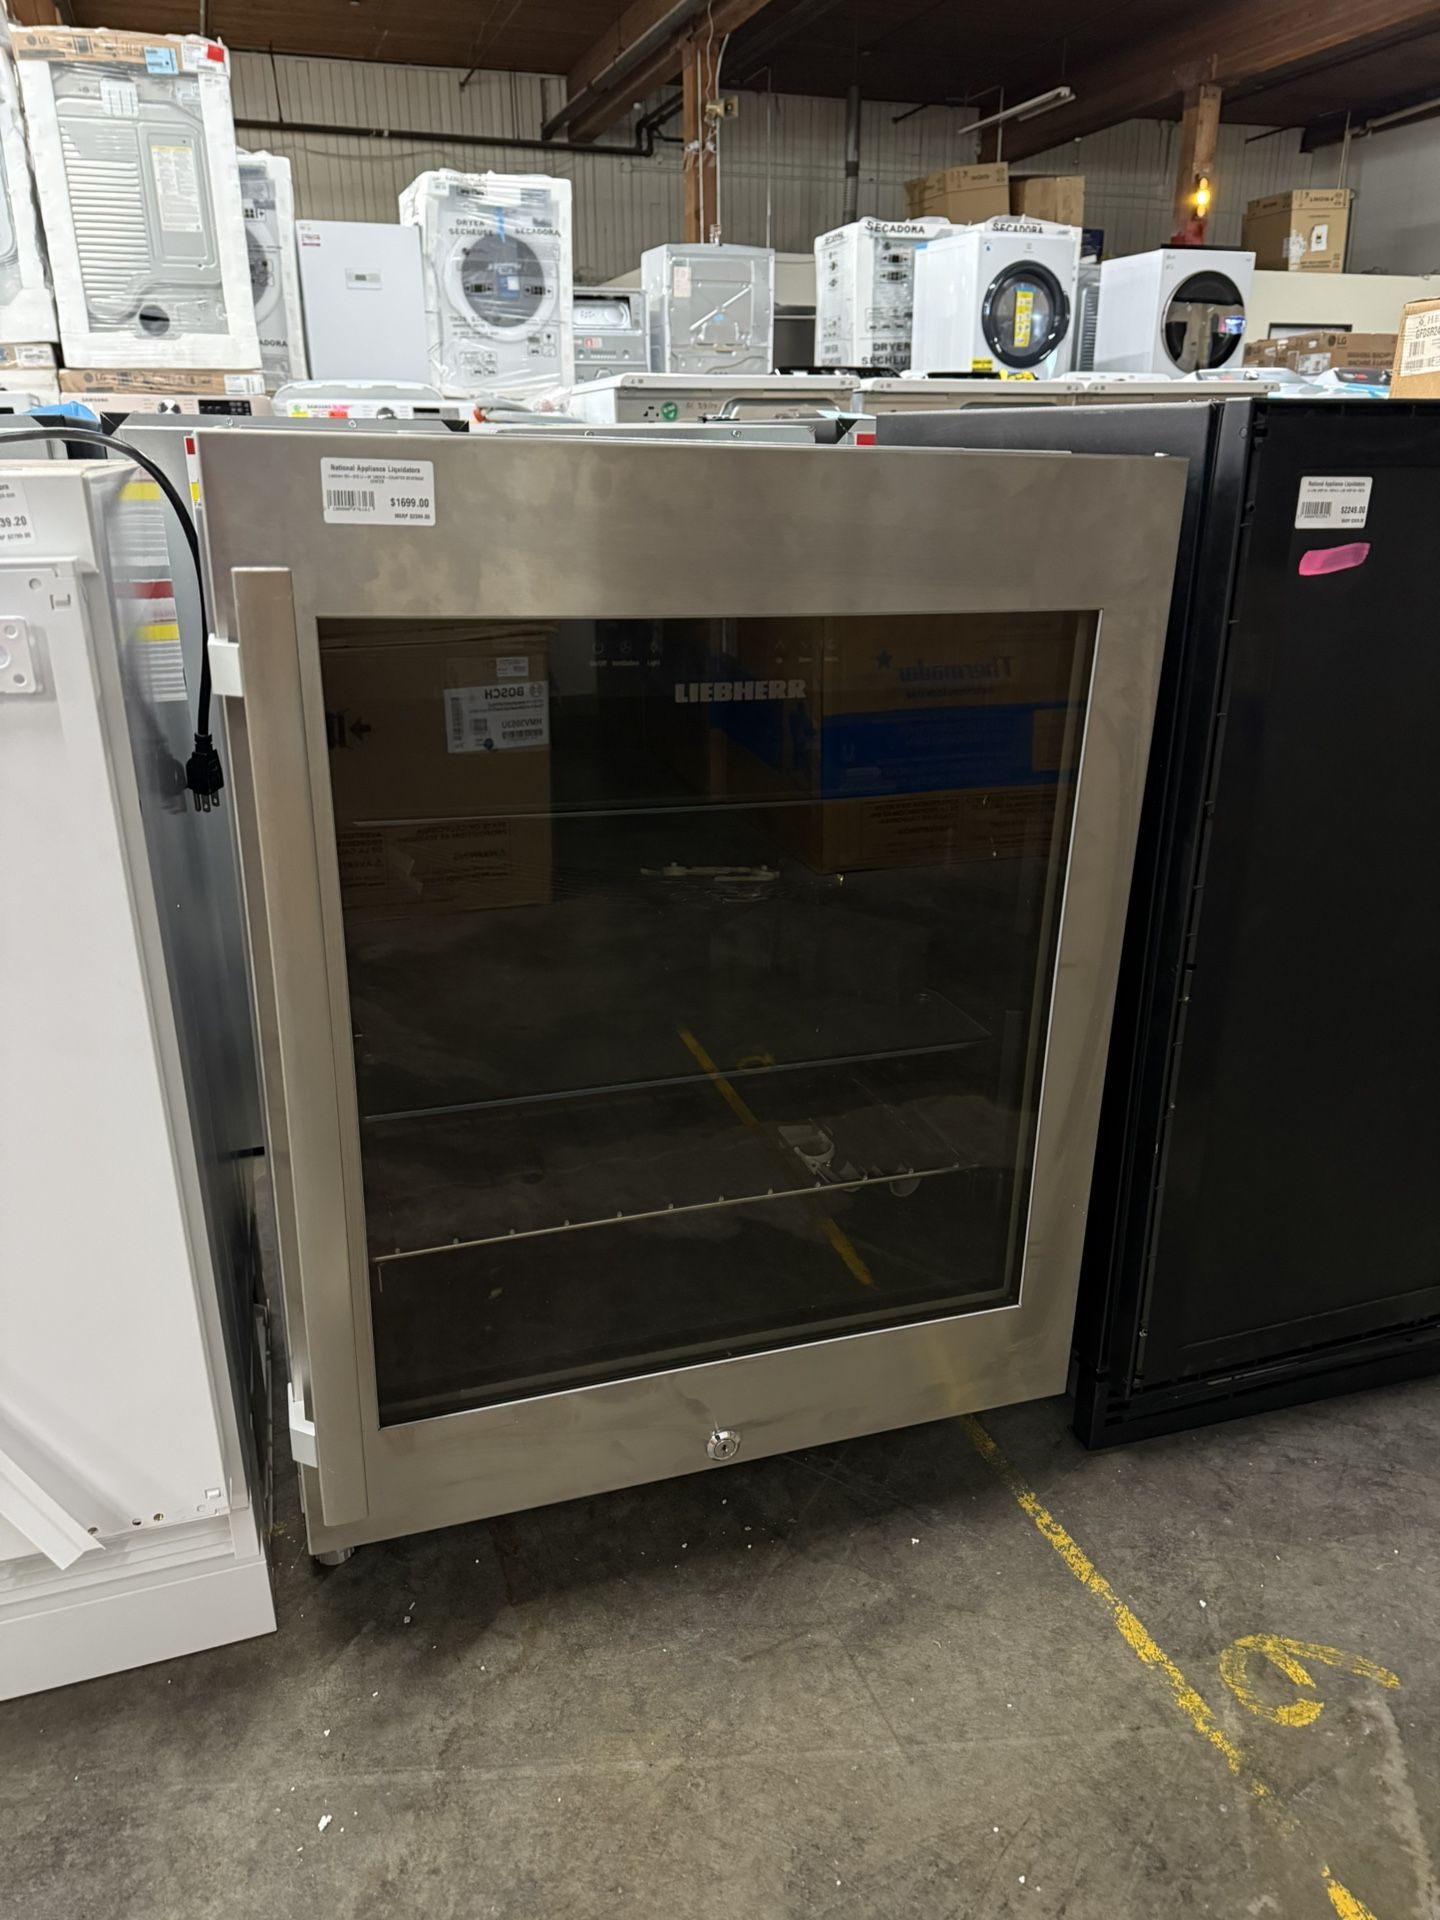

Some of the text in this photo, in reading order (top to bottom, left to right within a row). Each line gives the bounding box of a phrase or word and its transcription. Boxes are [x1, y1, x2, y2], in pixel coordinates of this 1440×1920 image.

[38, 35, 51, 45] LG
[456, 218, 485, 227] DRYER
[864, 220, 925, 235] SECADORA
[515, 228, 561, 238] SECADORA
[991, 222, 1044, 234] SECADORA
[1336, 336, 1347, 345] LG
[872, 342, 911, 352] DRYER
[330, 464, 420, 474] National Appliance Liquidators
[390, 497, 429, 508] $1699.00
[674, 679, 807, 703] LIEBHERR
